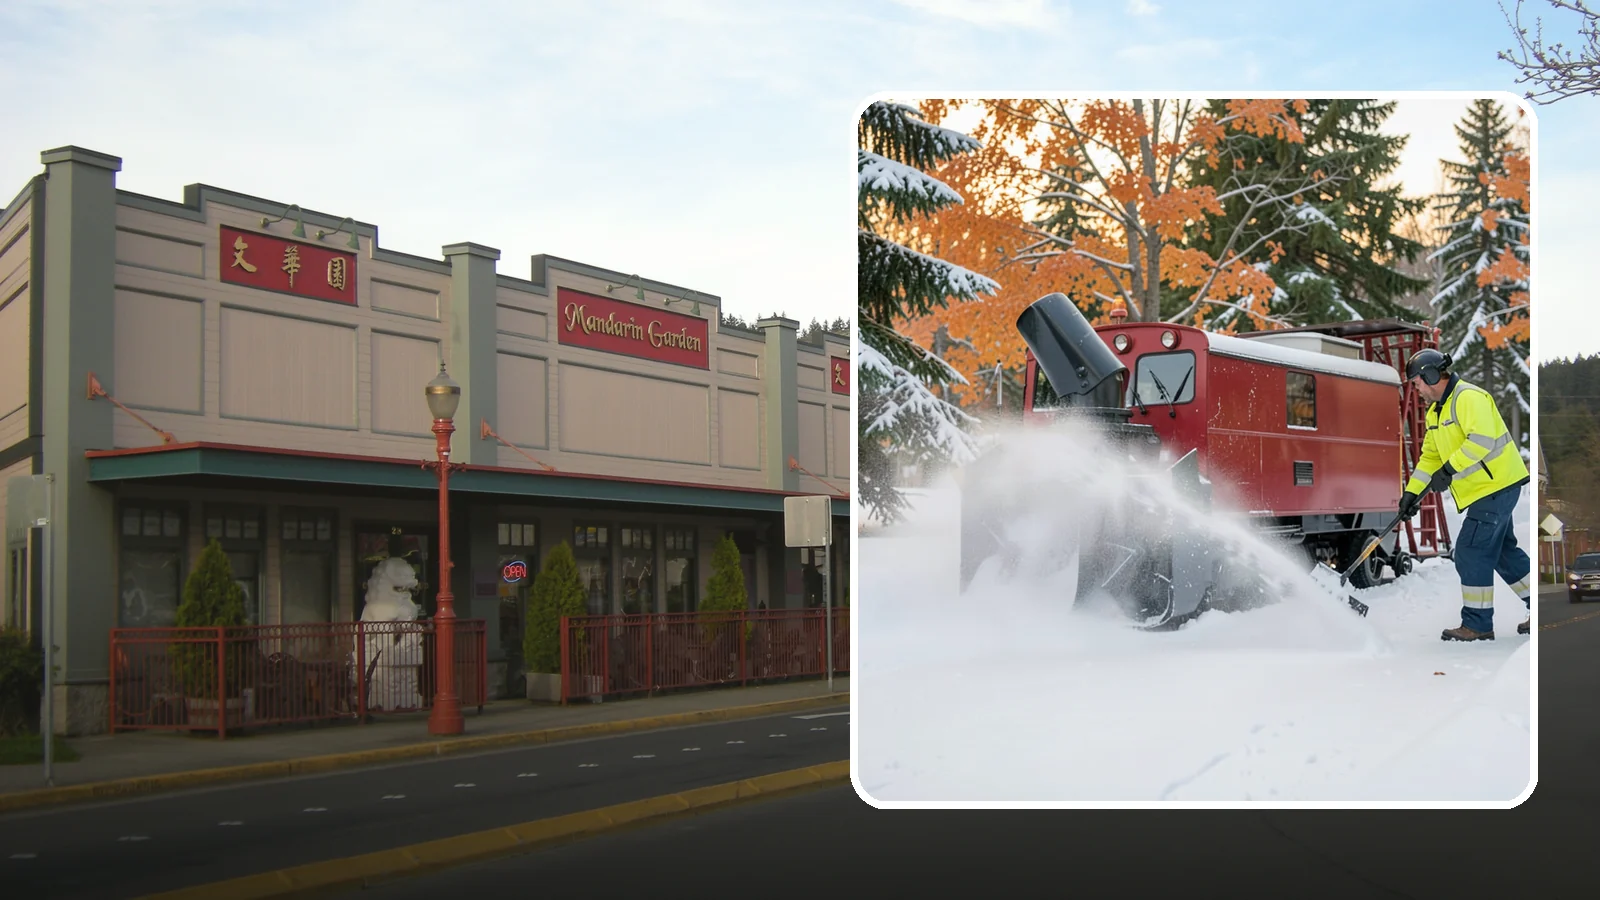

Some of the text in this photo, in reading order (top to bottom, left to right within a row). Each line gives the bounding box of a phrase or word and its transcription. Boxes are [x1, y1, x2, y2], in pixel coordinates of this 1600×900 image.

[231, 235, 346, 291] 文華園
[564, 302, 702, 352] Mandarin Garden
[503, 565, 527, 578] OPEN
